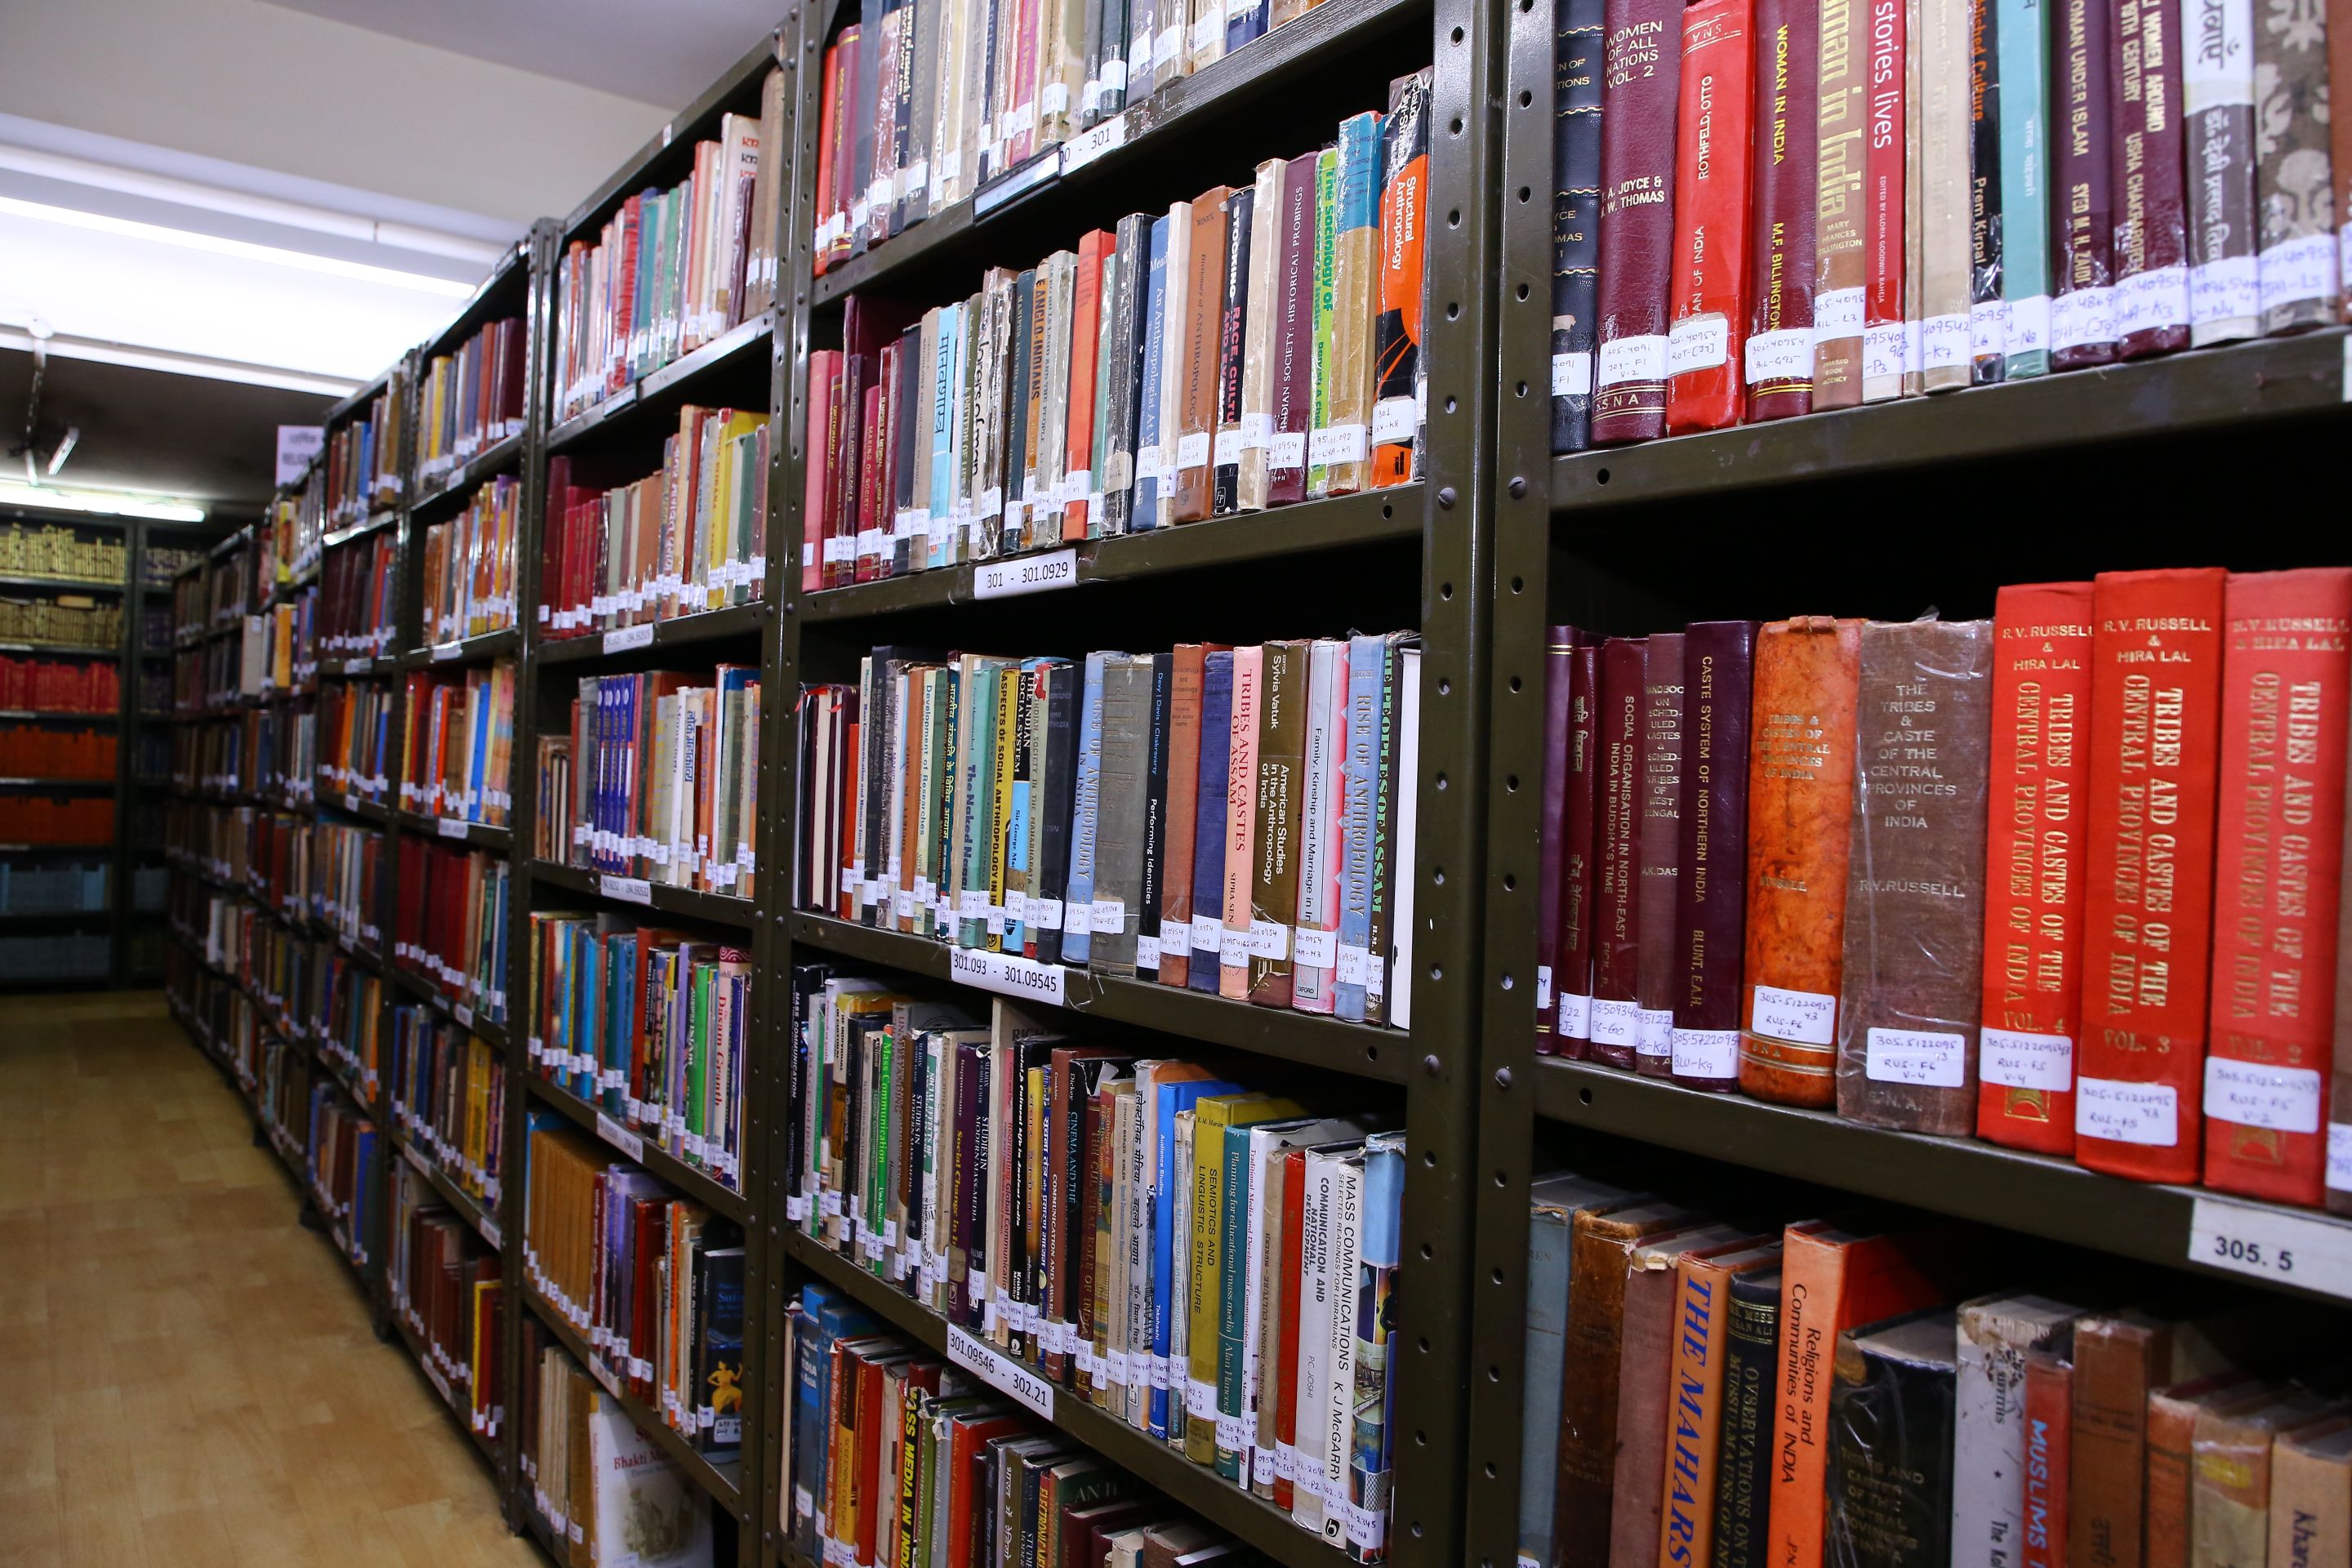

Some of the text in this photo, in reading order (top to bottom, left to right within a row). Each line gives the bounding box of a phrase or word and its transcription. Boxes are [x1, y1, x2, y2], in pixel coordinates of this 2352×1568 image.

[1606, 20, 1664, 49] WOMEN
[1606, 50, 1659, 78] NATIONS
[1608, 36, 1657, 62] OF ALL
[1607, 65, 1655, 90] VOL. 2
[1773, 23, 1788, 166] WOMAN IN INDIA
[1972, 60, 1987, 122] Culture
[2070, 49, 2089, 156] UNDER ISLAM
[2142, 11, 2165, 133] WOMEN AROUND
[1091, 127, 1111, 150] 301
[1820, 85, 1863, 221] in India
[1293, 186, 1303, 248] PROBINGS
[1392, 181, 1405, 270] Anthropology
[1404, 176, 1417, 242] Structural
[1620, 190, 1665, 207] THOMAS
[1826, 220, 1850, 232] MARY
[1879, 202, 1886, 214] BY
[1973, 177, 1987, 265] Prem Kirpal
[1229, 205, 1241, 300] STOCKING
[1694, 225, 1704, 287] OF INDIA
[1822, 229, 1856, 243] FRANCES
[1288, 250, 1300, 324] HISTORICAL
[1770, 253, 1783, 332] BILLINGTON
[1031, 291, 1046, 400] ANGLO-INDIANS
[1232, 306, 1241, 361] RACE,
[1283, 327, 1295, 383] SOCIETY:
[987, 559, 1069, 589] 301 301.0929
[1895, 684, 1928, 696] THE
[2116, 650, 2191, 664] HIRA LAL
[998, 675, 1009, 726] ASPECTS
[1013, 675, 1027, 773] SOCIAL SYSTEM
[1155, 699, 1163, 721] Davis
[1271, 655, 1282, 730] Sylvia Vatuk
[1882, 700, 1936, 712] TRIBES
[1900, 715, 1913, 727] &
[996, 744, 1005, 786] SOCIAL
[998, 727, 1006, 743] OF
[1152, 727, 1161, 776] Chakravarty
[1229, 715, 1240, 805] OF ASSAM
[1234, 668, 1254, 852] TRIBES AND CASTES
[1879, 747, 1937, 760] OF THE
[1883, 730, 1936, 742] CASTE
[963, 764, 977, 844] The Naked
[1695, 656, 1713, 904] CASTE SYSTEM OF NORTHERN INDIA
[1867, 782, 1958, 796] PROVINCES
[1870, 764, 1943, 780] CENTRAL
[990, 788, 1003, 880] ANTHROPOLOGY
[1276, 764, 1290, 875] American Studies
[1615, 696, 1634, 941] SOCIAL ORGANISATION IN NORTH-EAST
[1884, 816, 1928, 829] INDIA
[1895, 800, 1917, 812] OF
[1145, 799, 1158, 905] Performing Identities
[2037, 693, 2074, 992] TRIBES AND CASTES OF THE
[2107, 674, 2150, 1016] CENTRAL PROVINCES OF INDIA
[2139, 687, 2184, 1007] TRIBES AND CASTES OF THE
[954, 953, 1058, 992] 301.093 301.09545
[791, 1021, 800, 1099] COMMUNICATION
[878, 1041, 892, 1164] Mass Communication
[1205, 1168, 1218, 1267] SEMIOTICS AND
[1343, 1175, 1356, 1223] MASS
[1193, 1165, 1206, 1314] LINGUISTIC STRUCTURE
[1303, 1193, 1313, 1277] DEVELOPMENT
[1308, 1207, 1319, 1267] NATIONAL
[1315, 1177, 1330, 1303] COMMUNICATION AND
[1330, 1173, 1345, 1349] SELECTED READINGS FOR LIBRARIANS
[1337, 1226, 1356, 1372] COMMUNICATIONS
[950, 1332, 1047, 1407] 301.09546 302.21
[1334, 1381, 1343, 1392] K
[1781, 1282, 1807, 1484] Communities of INDIA
[1800, 1326, 1821, 1446] Religions and
[1330, 1409, 1343, 1483] McGARRY
[1667, 1274, 1713, 1568] THE MAHARS
[902, 1440, 915, 1499] MEDIA
[2029, 1419, 2048, 1549] MUSLIMS
[902, 1503, 912, 1526] IN
[1733, 1522, 1753, 1552] ON
